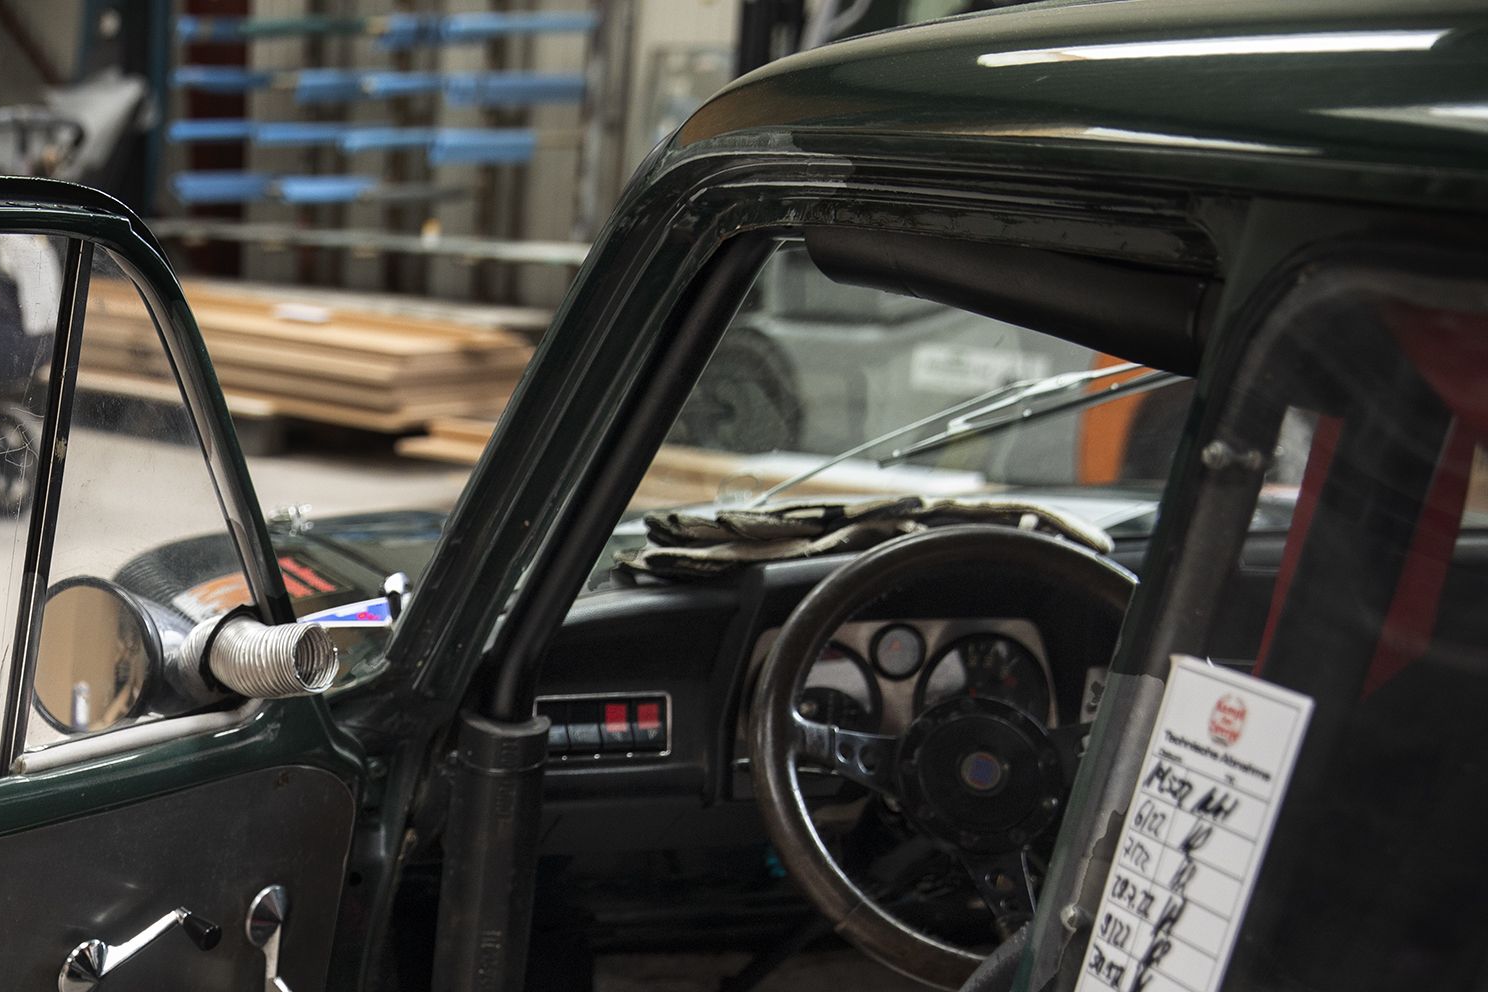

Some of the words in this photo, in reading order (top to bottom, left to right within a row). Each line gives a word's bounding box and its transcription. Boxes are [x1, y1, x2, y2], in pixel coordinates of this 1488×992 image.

[1165, 729, 1219, 760] Technische
[1220, 752, 1272, 783] Abnahme
[1133, 799, 1167, 838] 6/22
